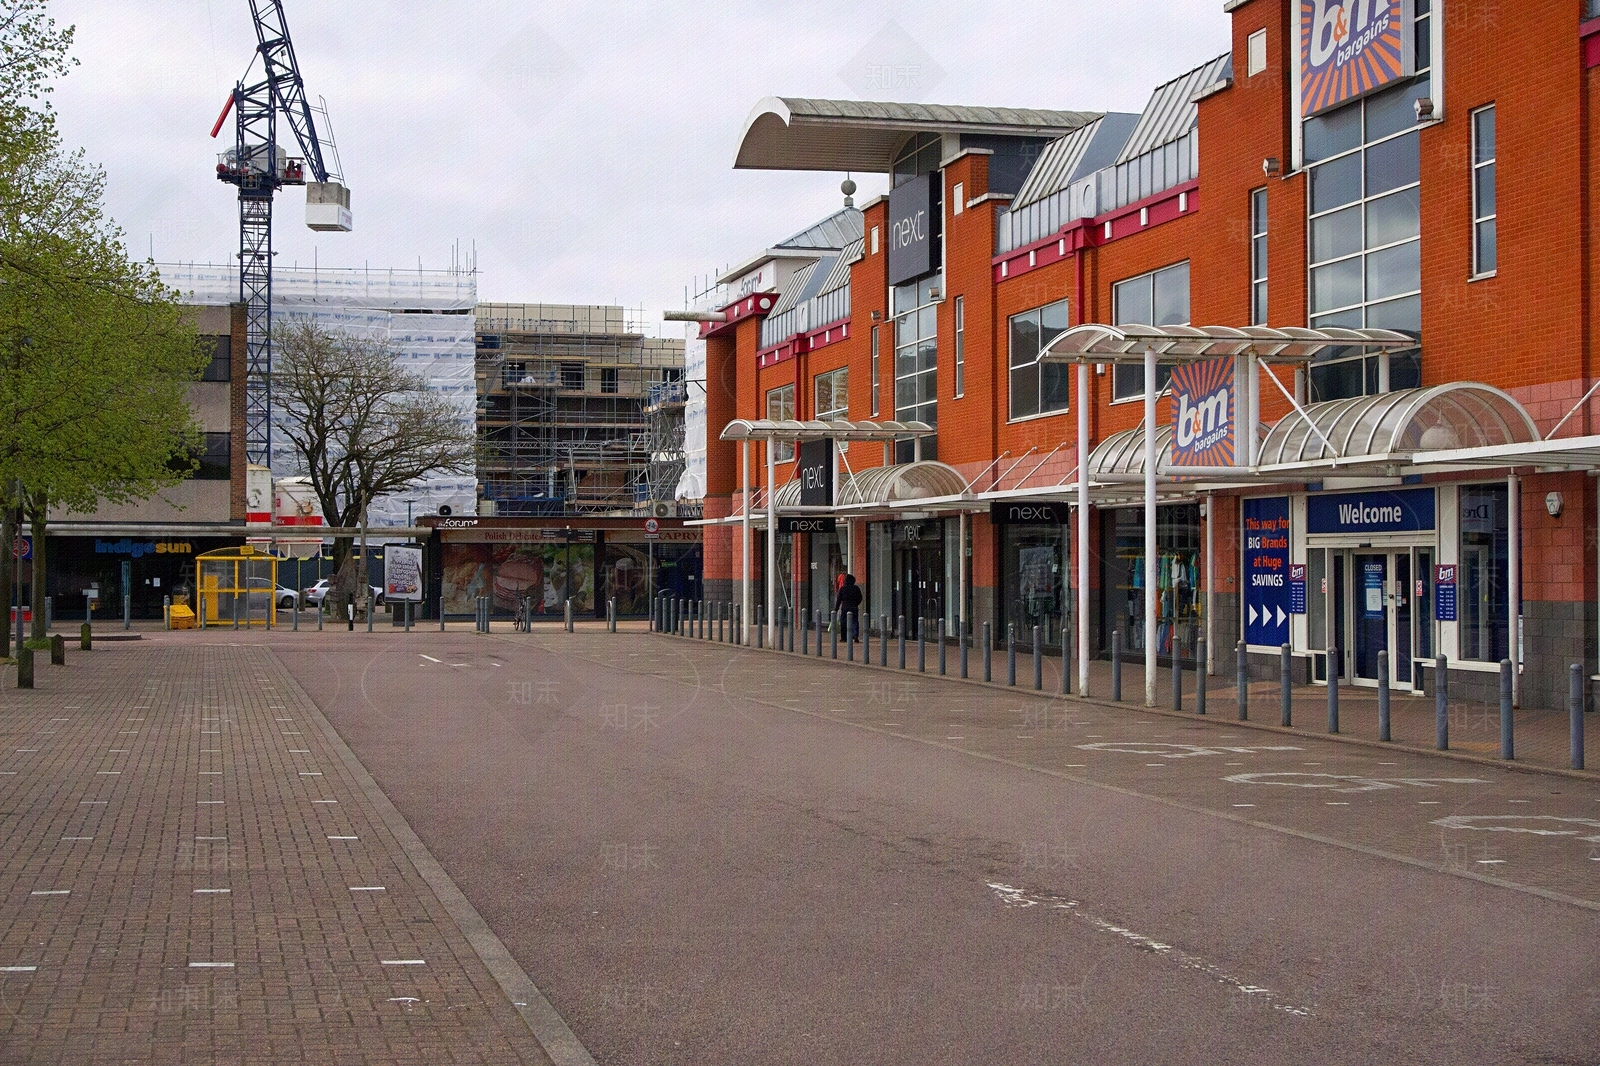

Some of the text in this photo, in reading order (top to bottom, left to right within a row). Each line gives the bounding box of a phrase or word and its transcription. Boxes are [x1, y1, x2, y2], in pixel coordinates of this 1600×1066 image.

[1336, 13, 1389, 67] bargains
[893, 210, 925, 251] next
[1177, 388, 1229, 447] b&m
[1194, 425, 1228, 453] bargains
[802, 464, 824, 490] next
[1009, 506, 1051, 520] next
[1338, 502, 1402, 525] Welcome
[790, 520, 824, 531] next
[904, 523, 921, 541] next
[1246, 515, 1290, 533] This way for
[485, 532, 507, 541] Polish
[509, 532, 555, 541] Delicates
[658, 532, 704, 540] KAPRY
[1248, 535, 1288, 549] BIG Brands
[95, 539, 192, 558] indigosun
[1253, 555, 1282, 571] at Huge
[1364, 564, 1383, 572] CLOSED
[1252, 574, 1283, 586] SAVINGS
